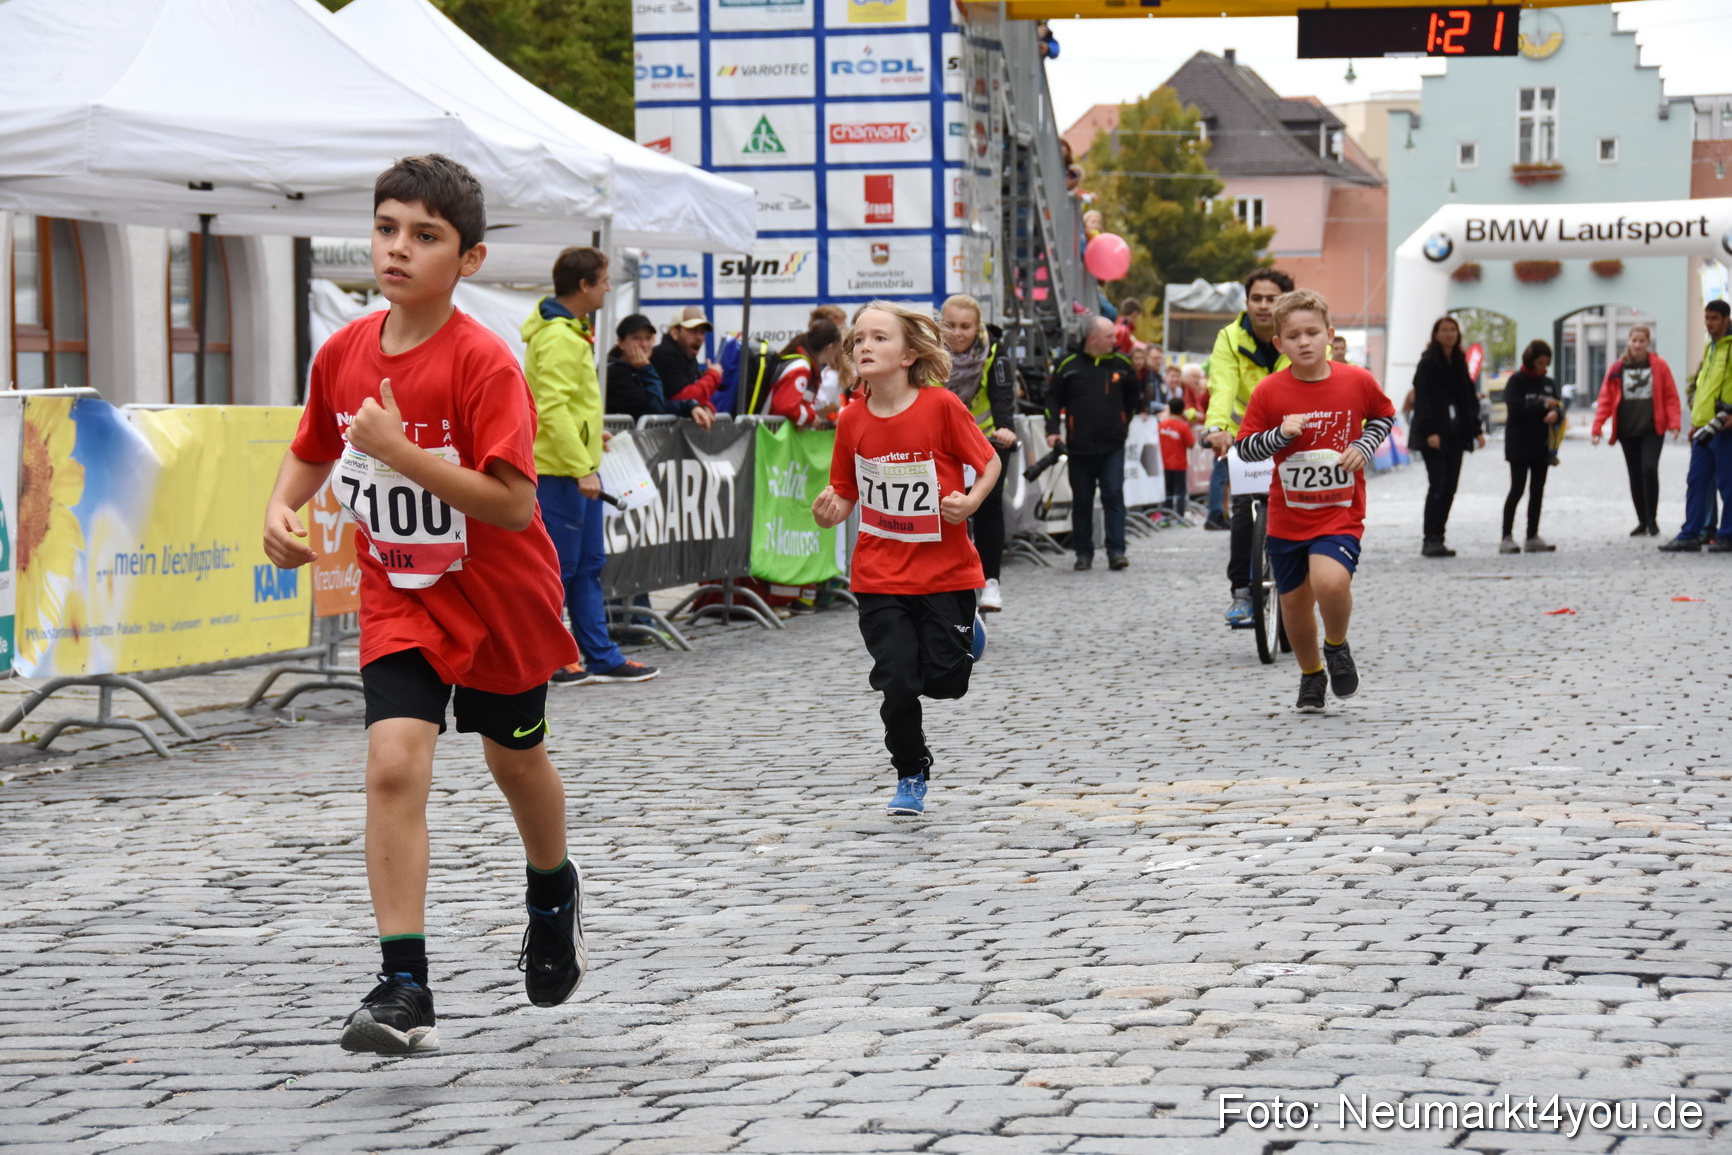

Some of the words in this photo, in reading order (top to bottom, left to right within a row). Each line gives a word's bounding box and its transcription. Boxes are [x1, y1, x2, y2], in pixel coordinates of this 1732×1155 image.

[1426, 10, 1505, 53] 1:21
[741, 63, 809, 76] VARIOTEC
[1465, 218, 1549, 243] BMW
[1558, 215, 1710, 245] Laufsport
[719, 259, 780, 277] swn
[884, 464, 928, 475] BOCK
[1286, 464, 1348, 488] 7230
[862, 476, 930, 512] 7172
[341, 475, 452, 537] 7100
[878, 516, 914, 531] Joshua
[454, 531, 461, 541] K
[379, 547, 415, 568] elix
[254, 564, 298, 603] KANN
